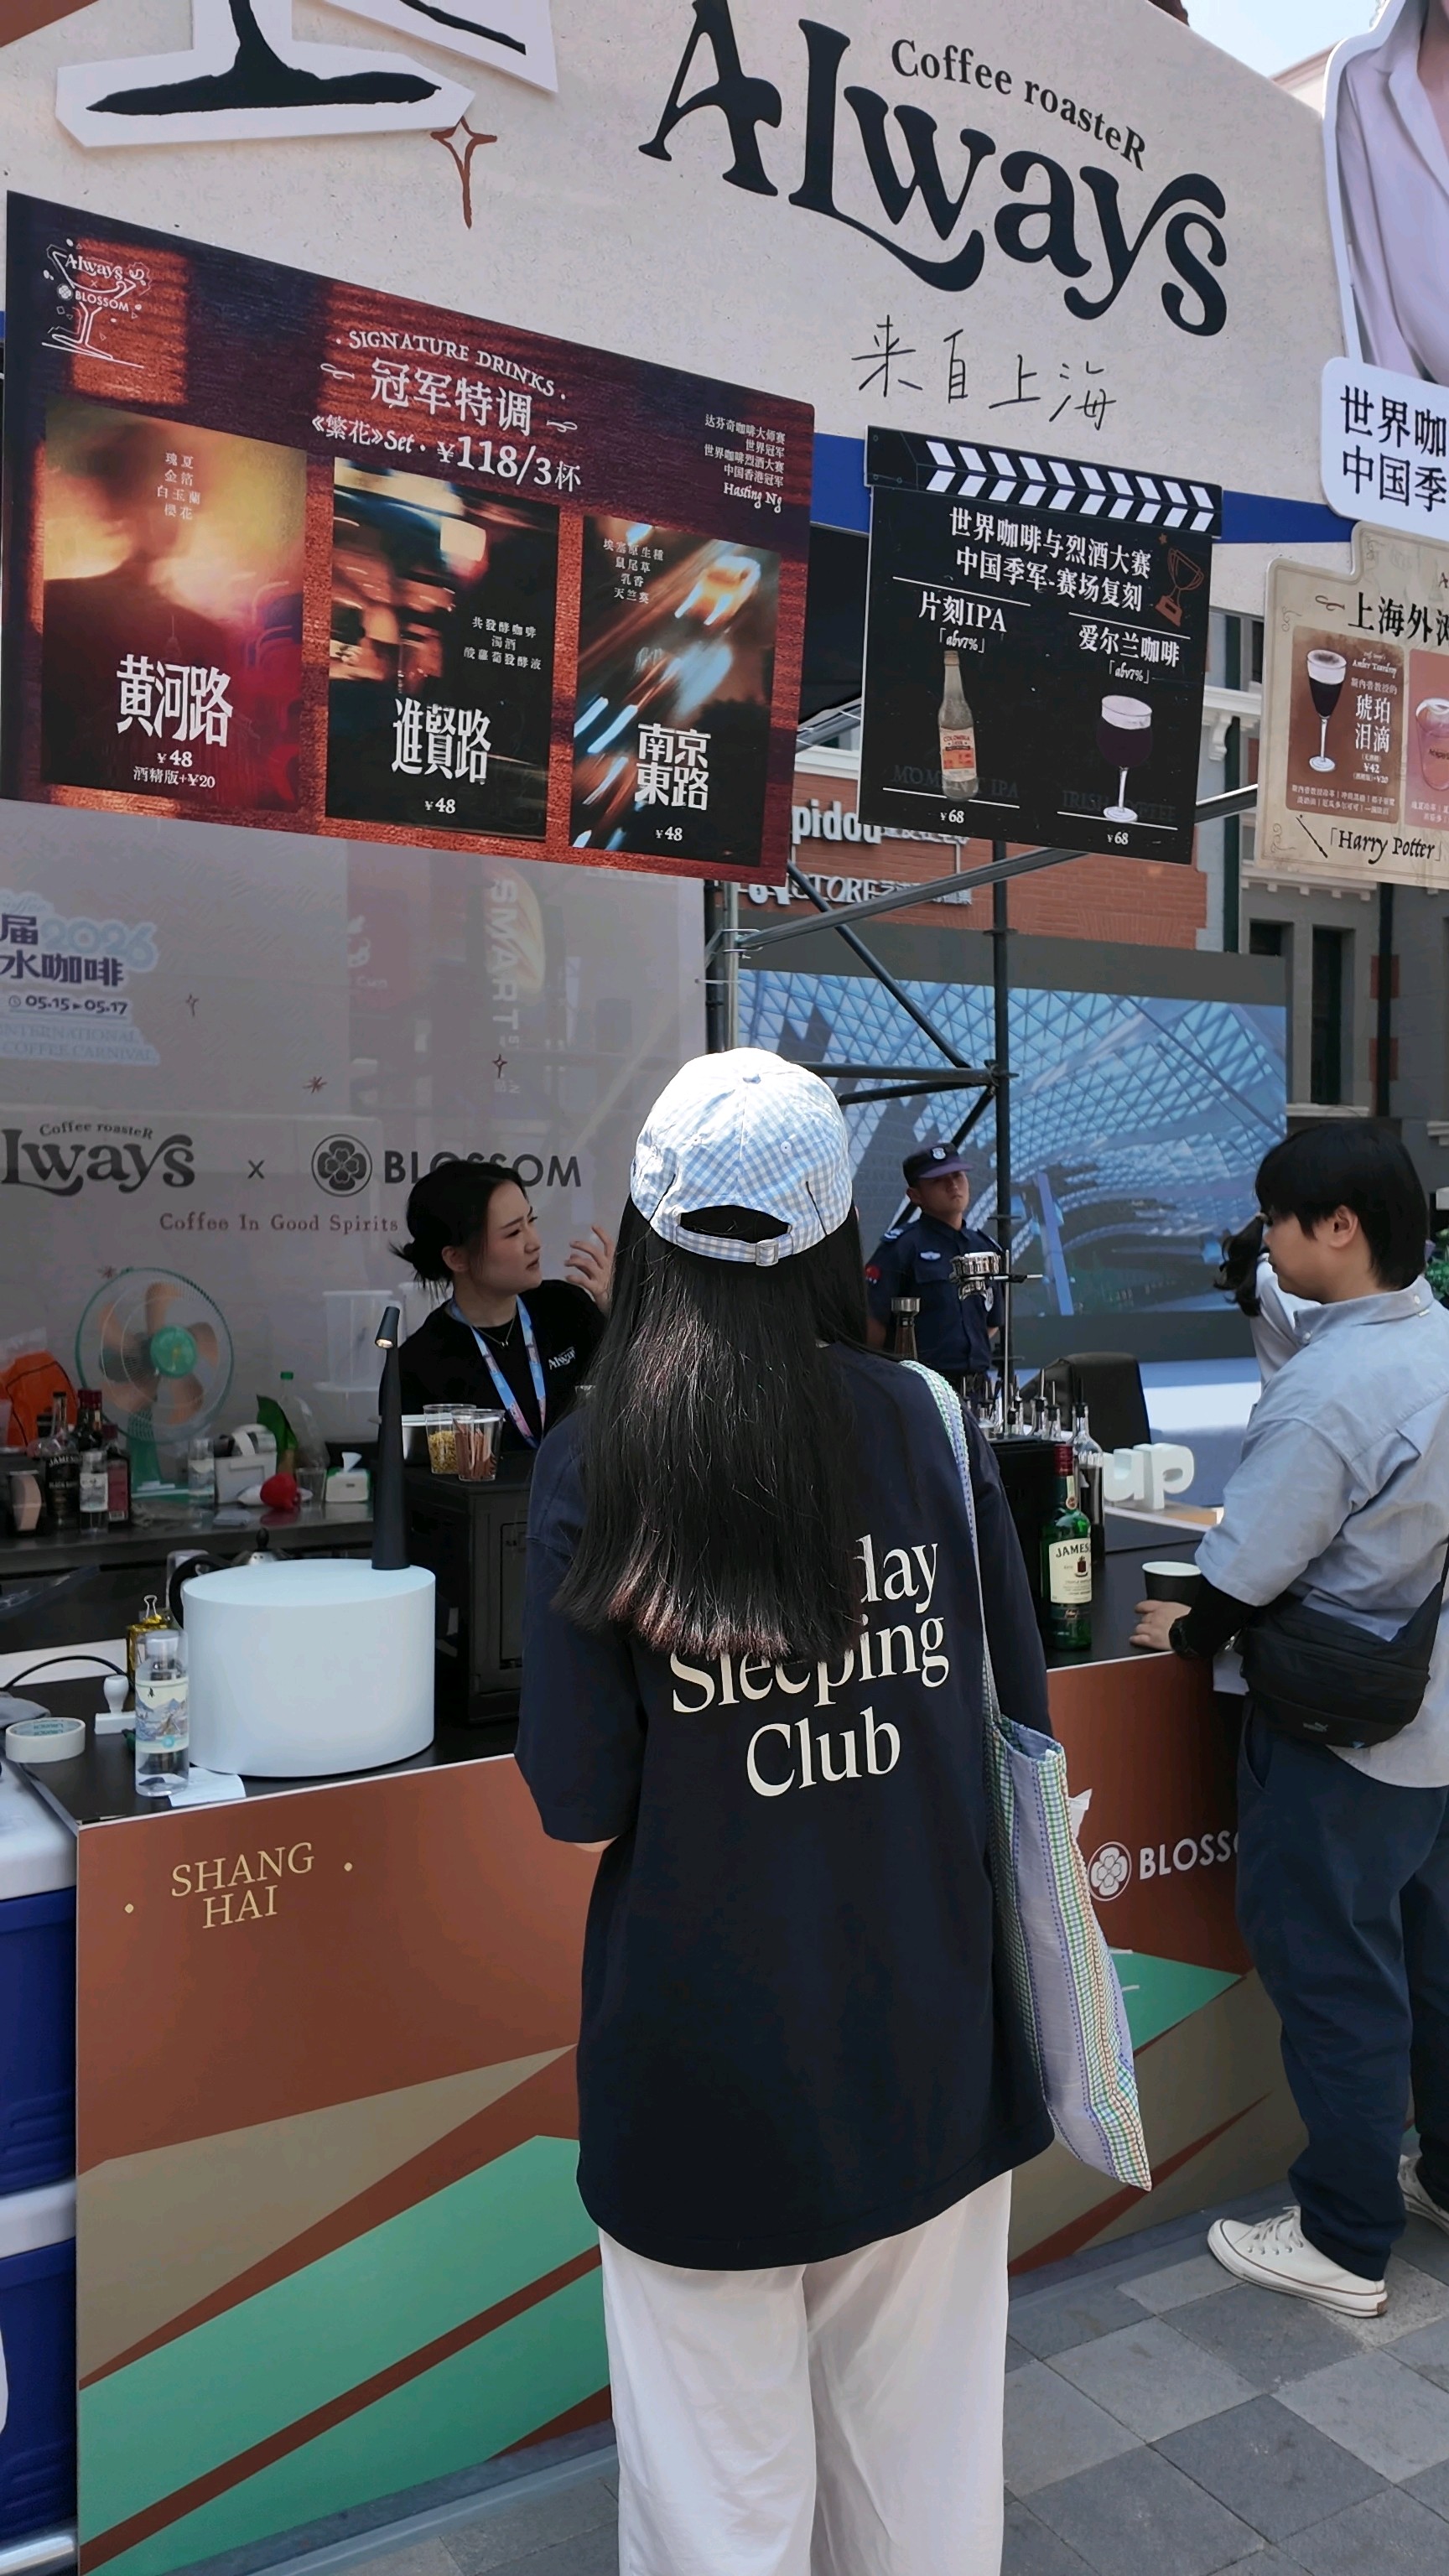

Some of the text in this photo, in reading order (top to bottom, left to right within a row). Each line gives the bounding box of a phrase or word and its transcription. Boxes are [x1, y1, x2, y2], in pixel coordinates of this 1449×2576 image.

[891, 39, 1148, 170] Coffee roasteR
[638, 0, 1228, 337] Always
[75, 290, 129, 312] BLOSSOM
[349, 330, 555, 397] SIGNATURE DRINKS
[852, 314, 1118, 432] 来自上海
[371, 357, 532, 437] 冠军特调
[704, 413, 786, 445] 达芬奇咖啡大师赛
[1340, 384, 1447, 457] 世界咖
[704, 443, 785, 474] 世界咖啡烈酒大赛
[745, 438, 785, 459] 世界冠军
[724, 463, 784, 488] 中国香港冠军
[724, 482, 782, 513] Hasting Ng
[1343, 444, 1448, 512] 中国季
[949, 506, 1152, 579] 世界咖啡与烈酒大赛
[956, 546, 1142, 612] 中国季军-赛场复刻
[918, 589, 1007, 633] 片刻IPA
[1078, 624, 1180, 667] 爱尔兰咖啡
[117, 654, 234, 747] 黄河路
[1355, 693, 1391, 724] 琥珀
[392, 698, 491, 786] 進賢路
[637, 723, 711, 769] 南京
[1355, 722, 1390, 753] 泪滴
[132, 766, 216, 788] 酒精版+¥20
[634, 761, 709, 811] 東路
[39, 1120, 92, 1137] Coffee
[384, 1150, 582, 1187] BLOM
[159, 1211, 398, 1235] Coffee In Good Spirits
[1055, 1543, 1091, 1558] JAMES
[746, 1706, 901, 1798] Club
[171, 1841, 315, 1897] SHANG
[1140, 1830, 1239, 1880] BLOSS
[202, 1884, 278, 1929] HAI
